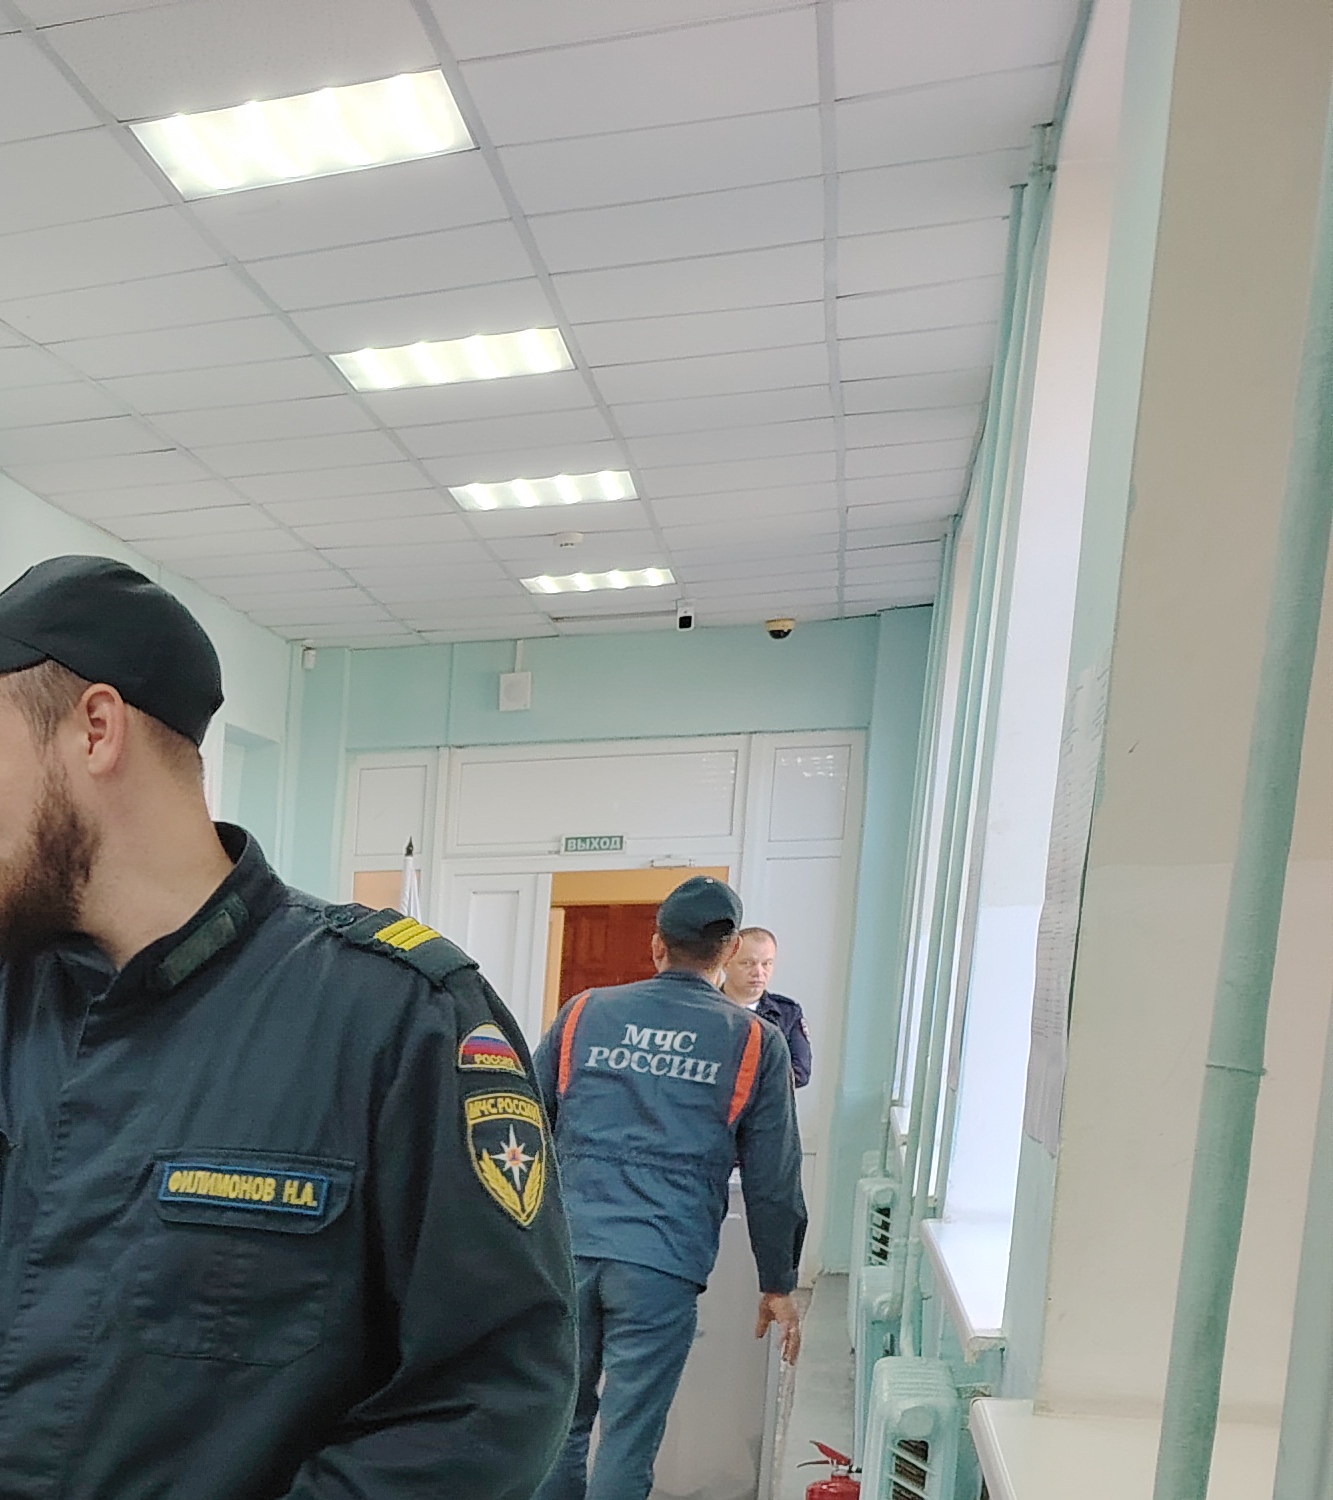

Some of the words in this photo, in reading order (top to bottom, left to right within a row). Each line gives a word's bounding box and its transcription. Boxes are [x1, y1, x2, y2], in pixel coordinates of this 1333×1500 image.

[567, 837, 621, 851] ВЫХОД
[621, 1023, 697, 1053] МЧС
[585, 1046, 722, 1085] РОССИИ
[168, 1170, 276, 1202] ФИЛИМОНОВ
